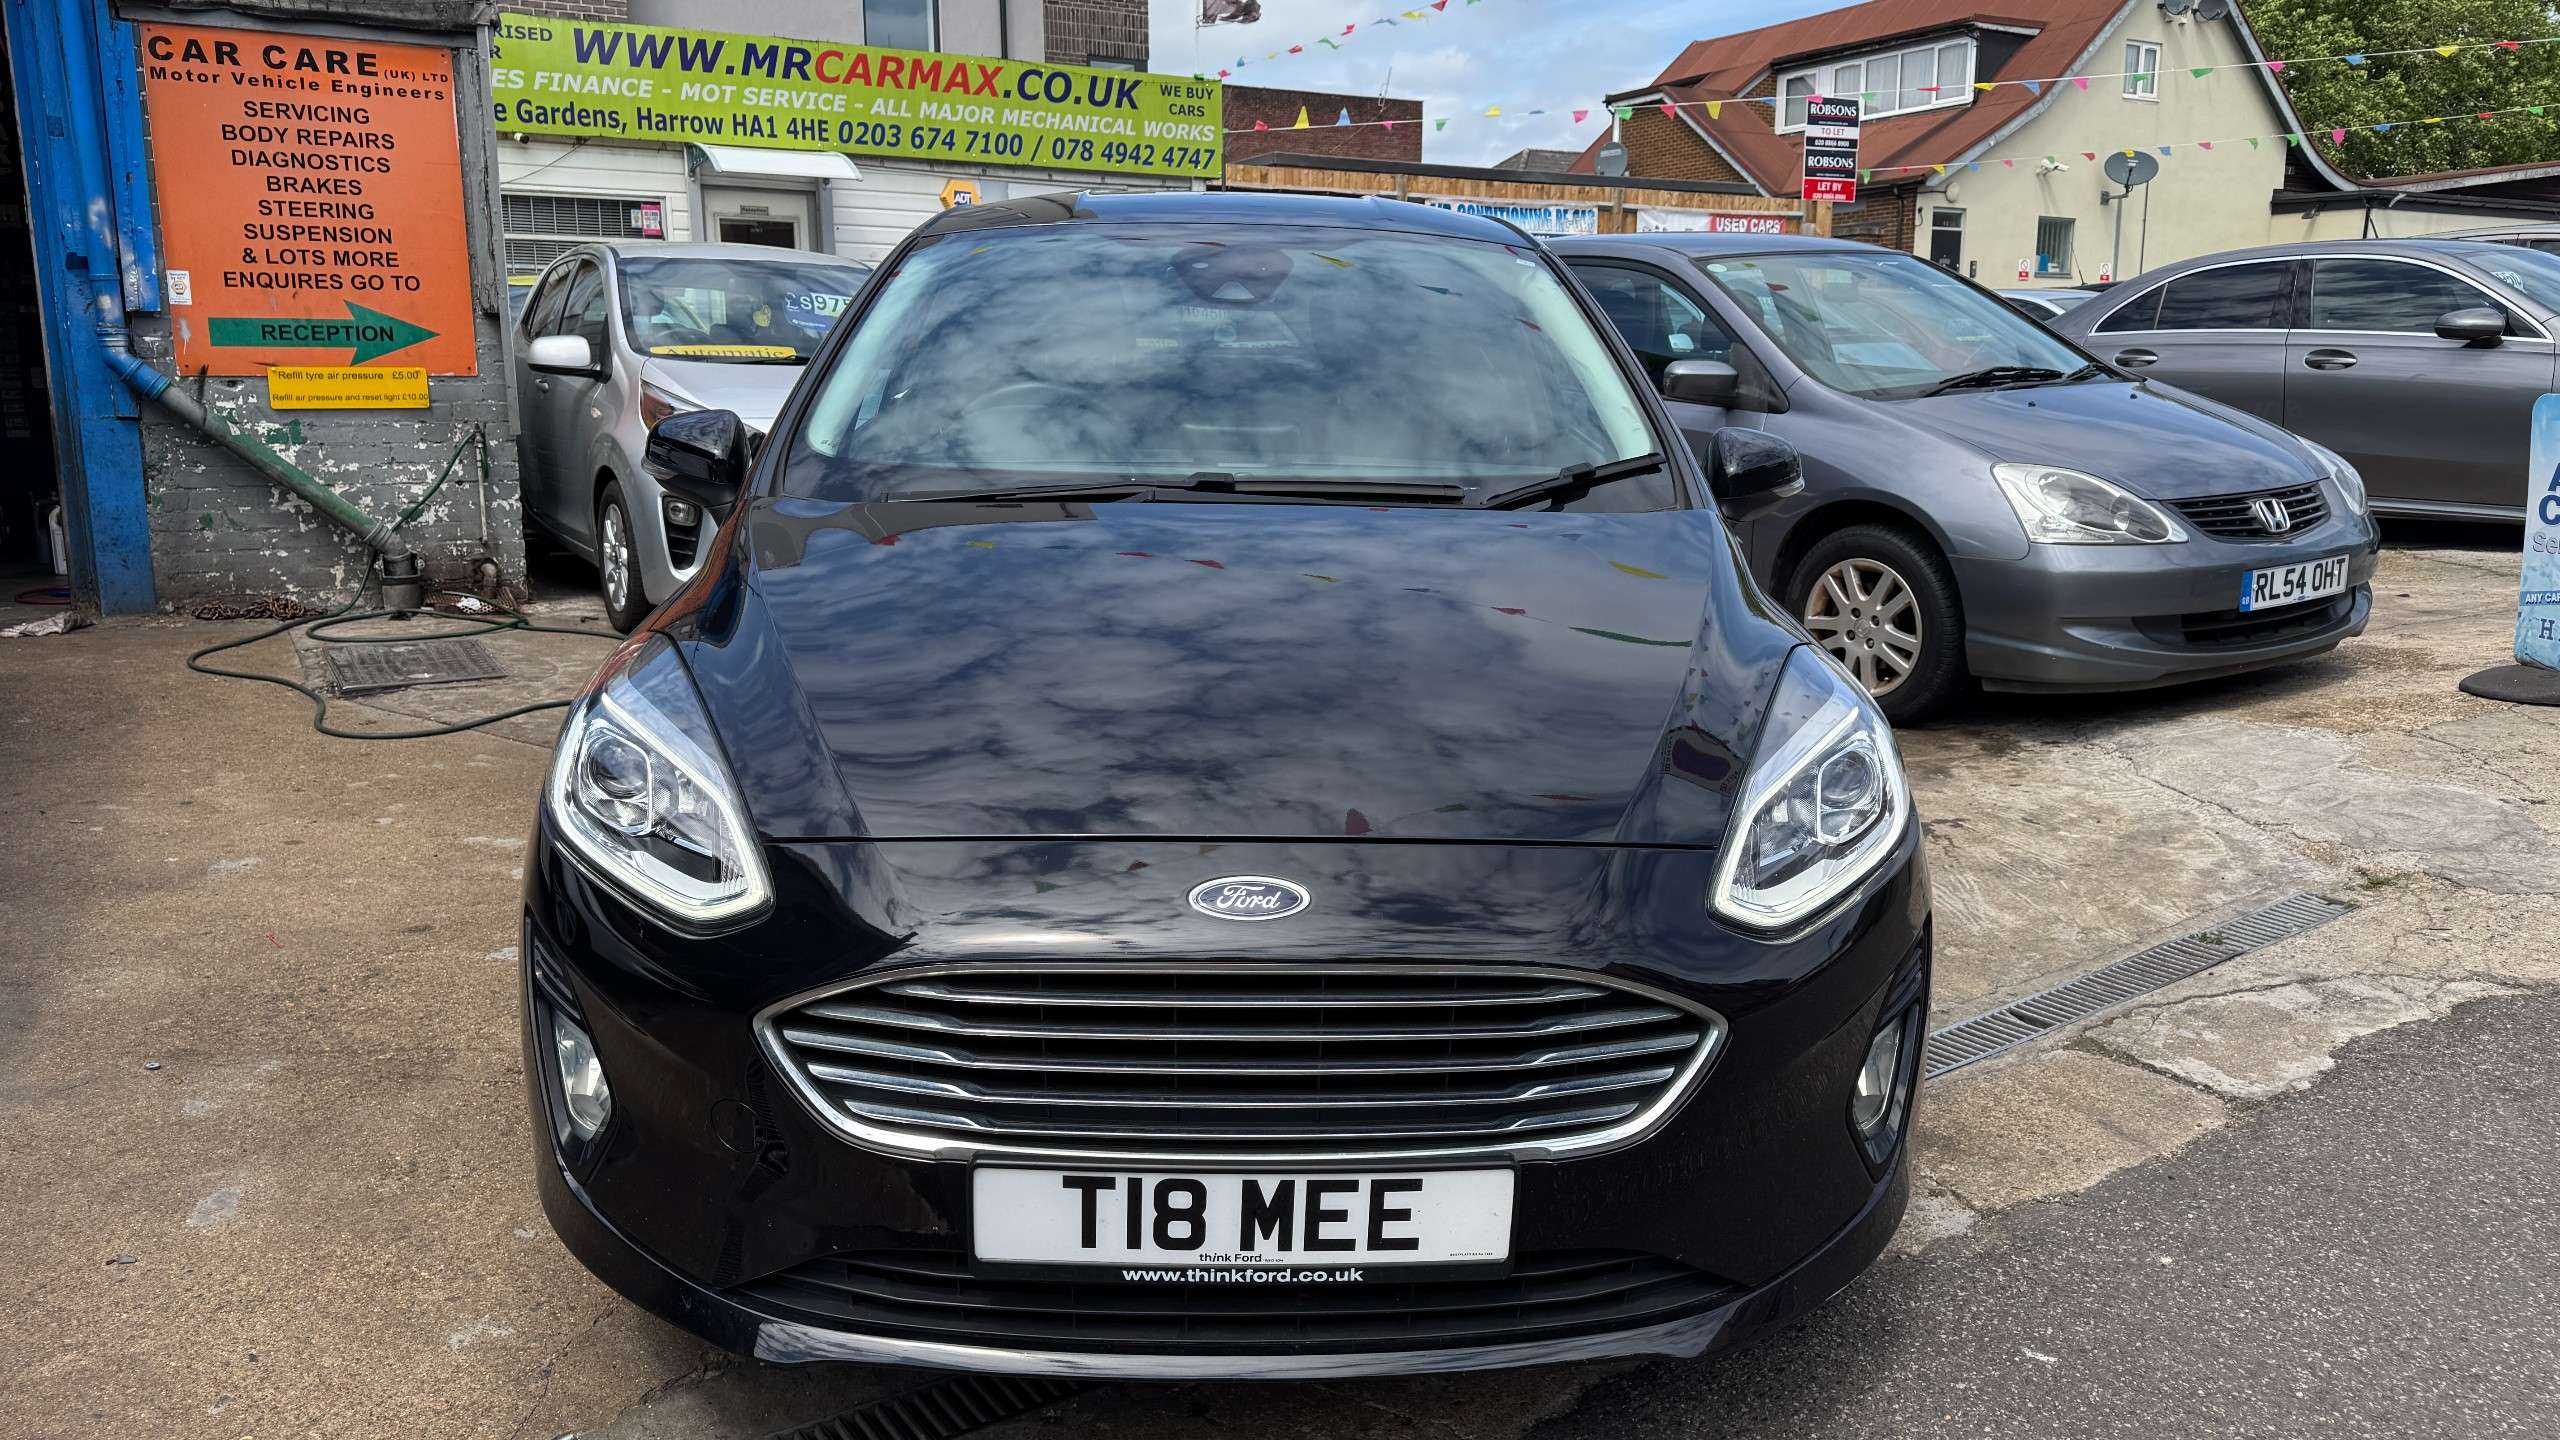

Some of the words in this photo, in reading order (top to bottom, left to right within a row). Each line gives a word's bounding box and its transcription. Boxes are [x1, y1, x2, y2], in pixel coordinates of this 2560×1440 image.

[148, 36, 241, 66] CAR
[262, 45, 378, 77] CARE
[384, 69, 416, 83] (UK)
[422, 72, 449, 83] LTD
[573, 28, 1143, 110] WWW.MRCARMAX.CO.UK
[149, 66, 220, 83] Motor
[231, 71, 320, 91] Vehicle
[331, 79, 445, 100] Engineers
[1160, 84, 1181, 98] WE
[1186, 87, 1214, 100] BUY
[243, 100, 370, 124] SERVICING
[533, 71, 654, 98] FINANCE
[680, 82, 737, 103] MOT
[742, 86, 848, 112] SERVICE
[870, 97, 912, 118] ALL
[919, 101, 994, 125] MAJOR
[1001, 108, 1137, 137] MECHANICAL
[1144, 120, 1215, 142] WORKS
[1169, 103, 1205, 118] CARS
[1810, 103, 1857, 117] ROBSONS
[221, 124, 289, 144] BODY
[296, 128, 395, 150] REPAIRS
[494, 101, 507, 122] e
[516, 98, 628, 134] Gardens,
[636, 106, 724, 135] Harrow
[732, 113, 778, 139] HA1
[786, 117, 830, 143] 4HE
[838, 120, 901, 148] 0203
[910, 126, 956, 151] 674
[964, 131, 1023, 156] 7100
[1030, 135, 1044, 161] /
[1052, 137, 1094, 162] 078
[1100, 141, 1154, 166] 4942
[1161, 146, 1216, 170] 4747
[1821, 127, 1831, 136] TO
[1833, 127, 1845, 136] LET
[231, 149, 391, 173] DIAGNOSTICS
[1807, 155, 1854, 168] ROBSONS
[266, 175, 363, 196] BRAKES
[1817, 181, 1831, 191] LET
[1832, 183, 1842, 192] BY
[954, 192, 971, 204] ADT
[258, 199, 375, 220] STEERING
[243, 223, 393, 244] SUSPENSION
[1716, 217, 1748, 232] USED
[1750, 218, 1781, 233] CARS
[242, 247, 258, 265] &
[265, 248, 326, 266] LOTS
[333, 250, 400, 268] MORE
[223, 271, 344, 290] ENQUIRES
[350, 274, 385, 291] GO
[391, 275, 421, 291] TO
[261, 324, 394, 342] RECEPTION
[306, 371, 325, 381] tyre
[327, 371, 339, 380] air
[342, 371, 384, 382] pressure
[273, 393, 293, 401] Refill
[308, 394, 343, 402] pressure
[345, 393, 360, 401] and
[363, 393, 382, 401] reset
[2533, 532, 2560, 555] Se
[2255, 565, 2307, 603] RL54
[2312, 557, 2347, 592] OHT
[2525, 592, 2543, 604] ANY
[1217, 885, 1281, 908] Ford
[1239, 1178, 1424, 1252] MEE
[1199, 1252, 1232, 1263] think
[1234, 1253, 1262, 1263] Ford
[1122, 1266, 1365, 1284] www.thinkford.co.uk
